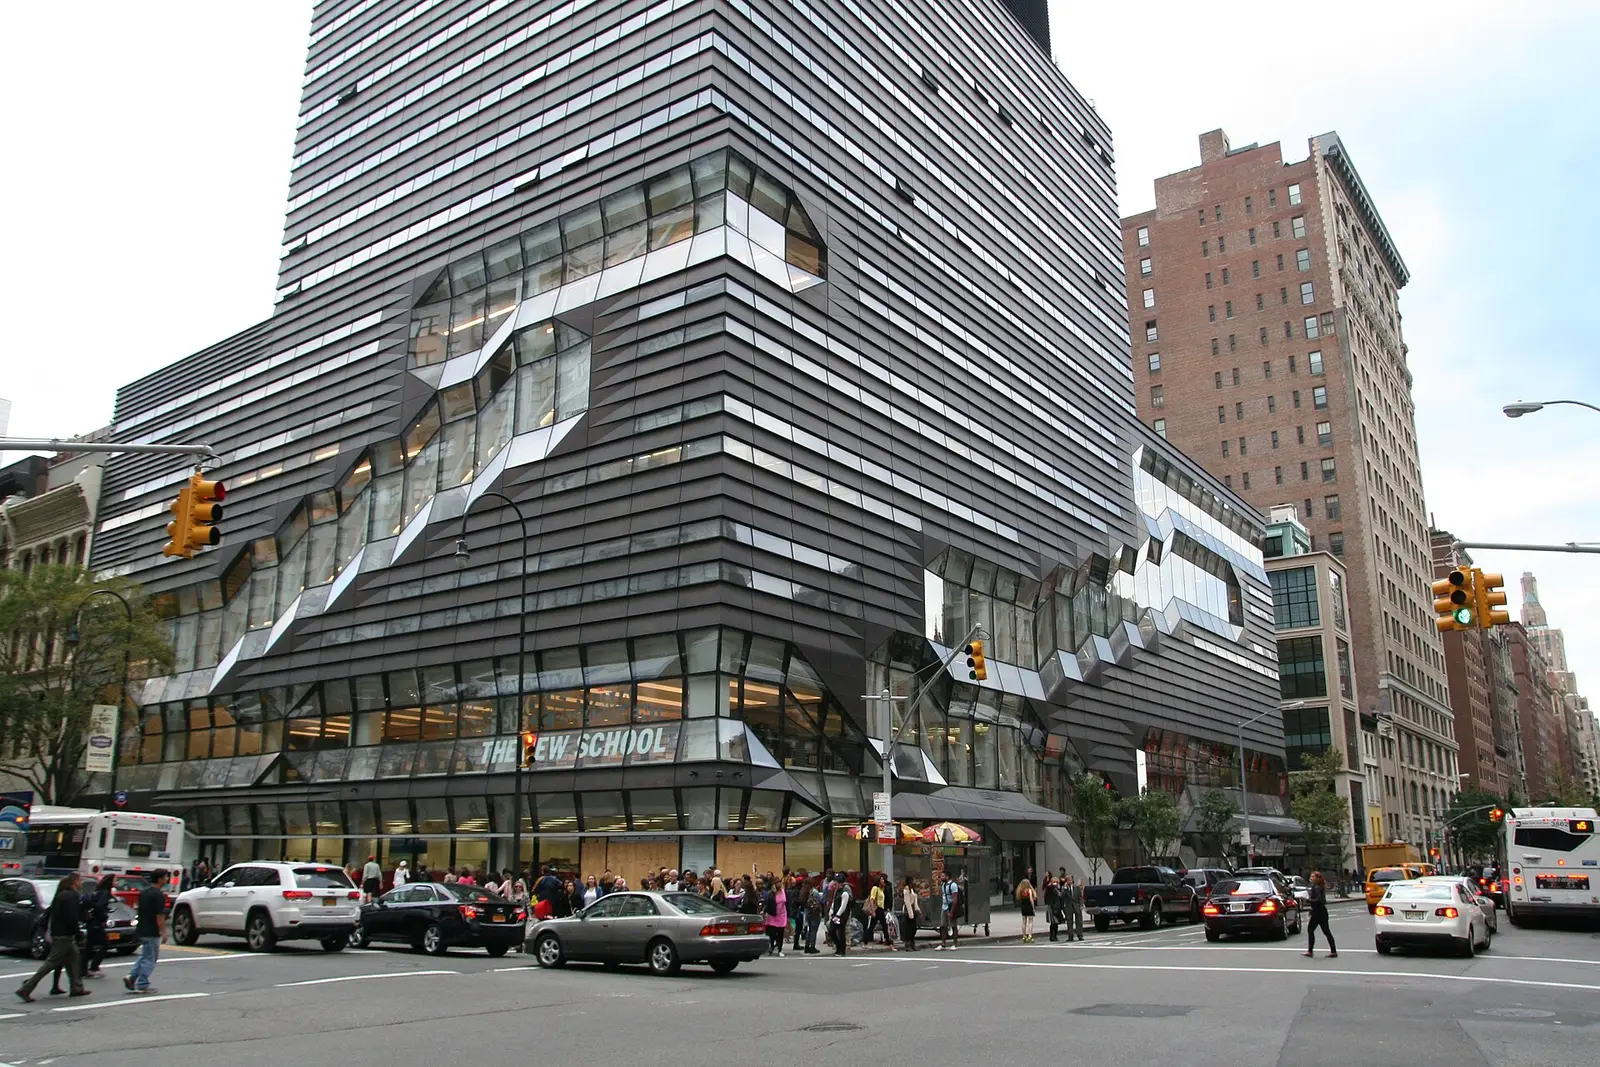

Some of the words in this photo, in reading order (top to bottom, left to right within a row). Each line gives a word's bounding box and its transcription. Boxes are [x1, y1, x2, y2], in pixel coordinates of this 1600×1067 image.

[481, 739, 517, 764] THE
[522, 734, 571, 761] EW
[574, 727, 667, 759] SCHOOL
